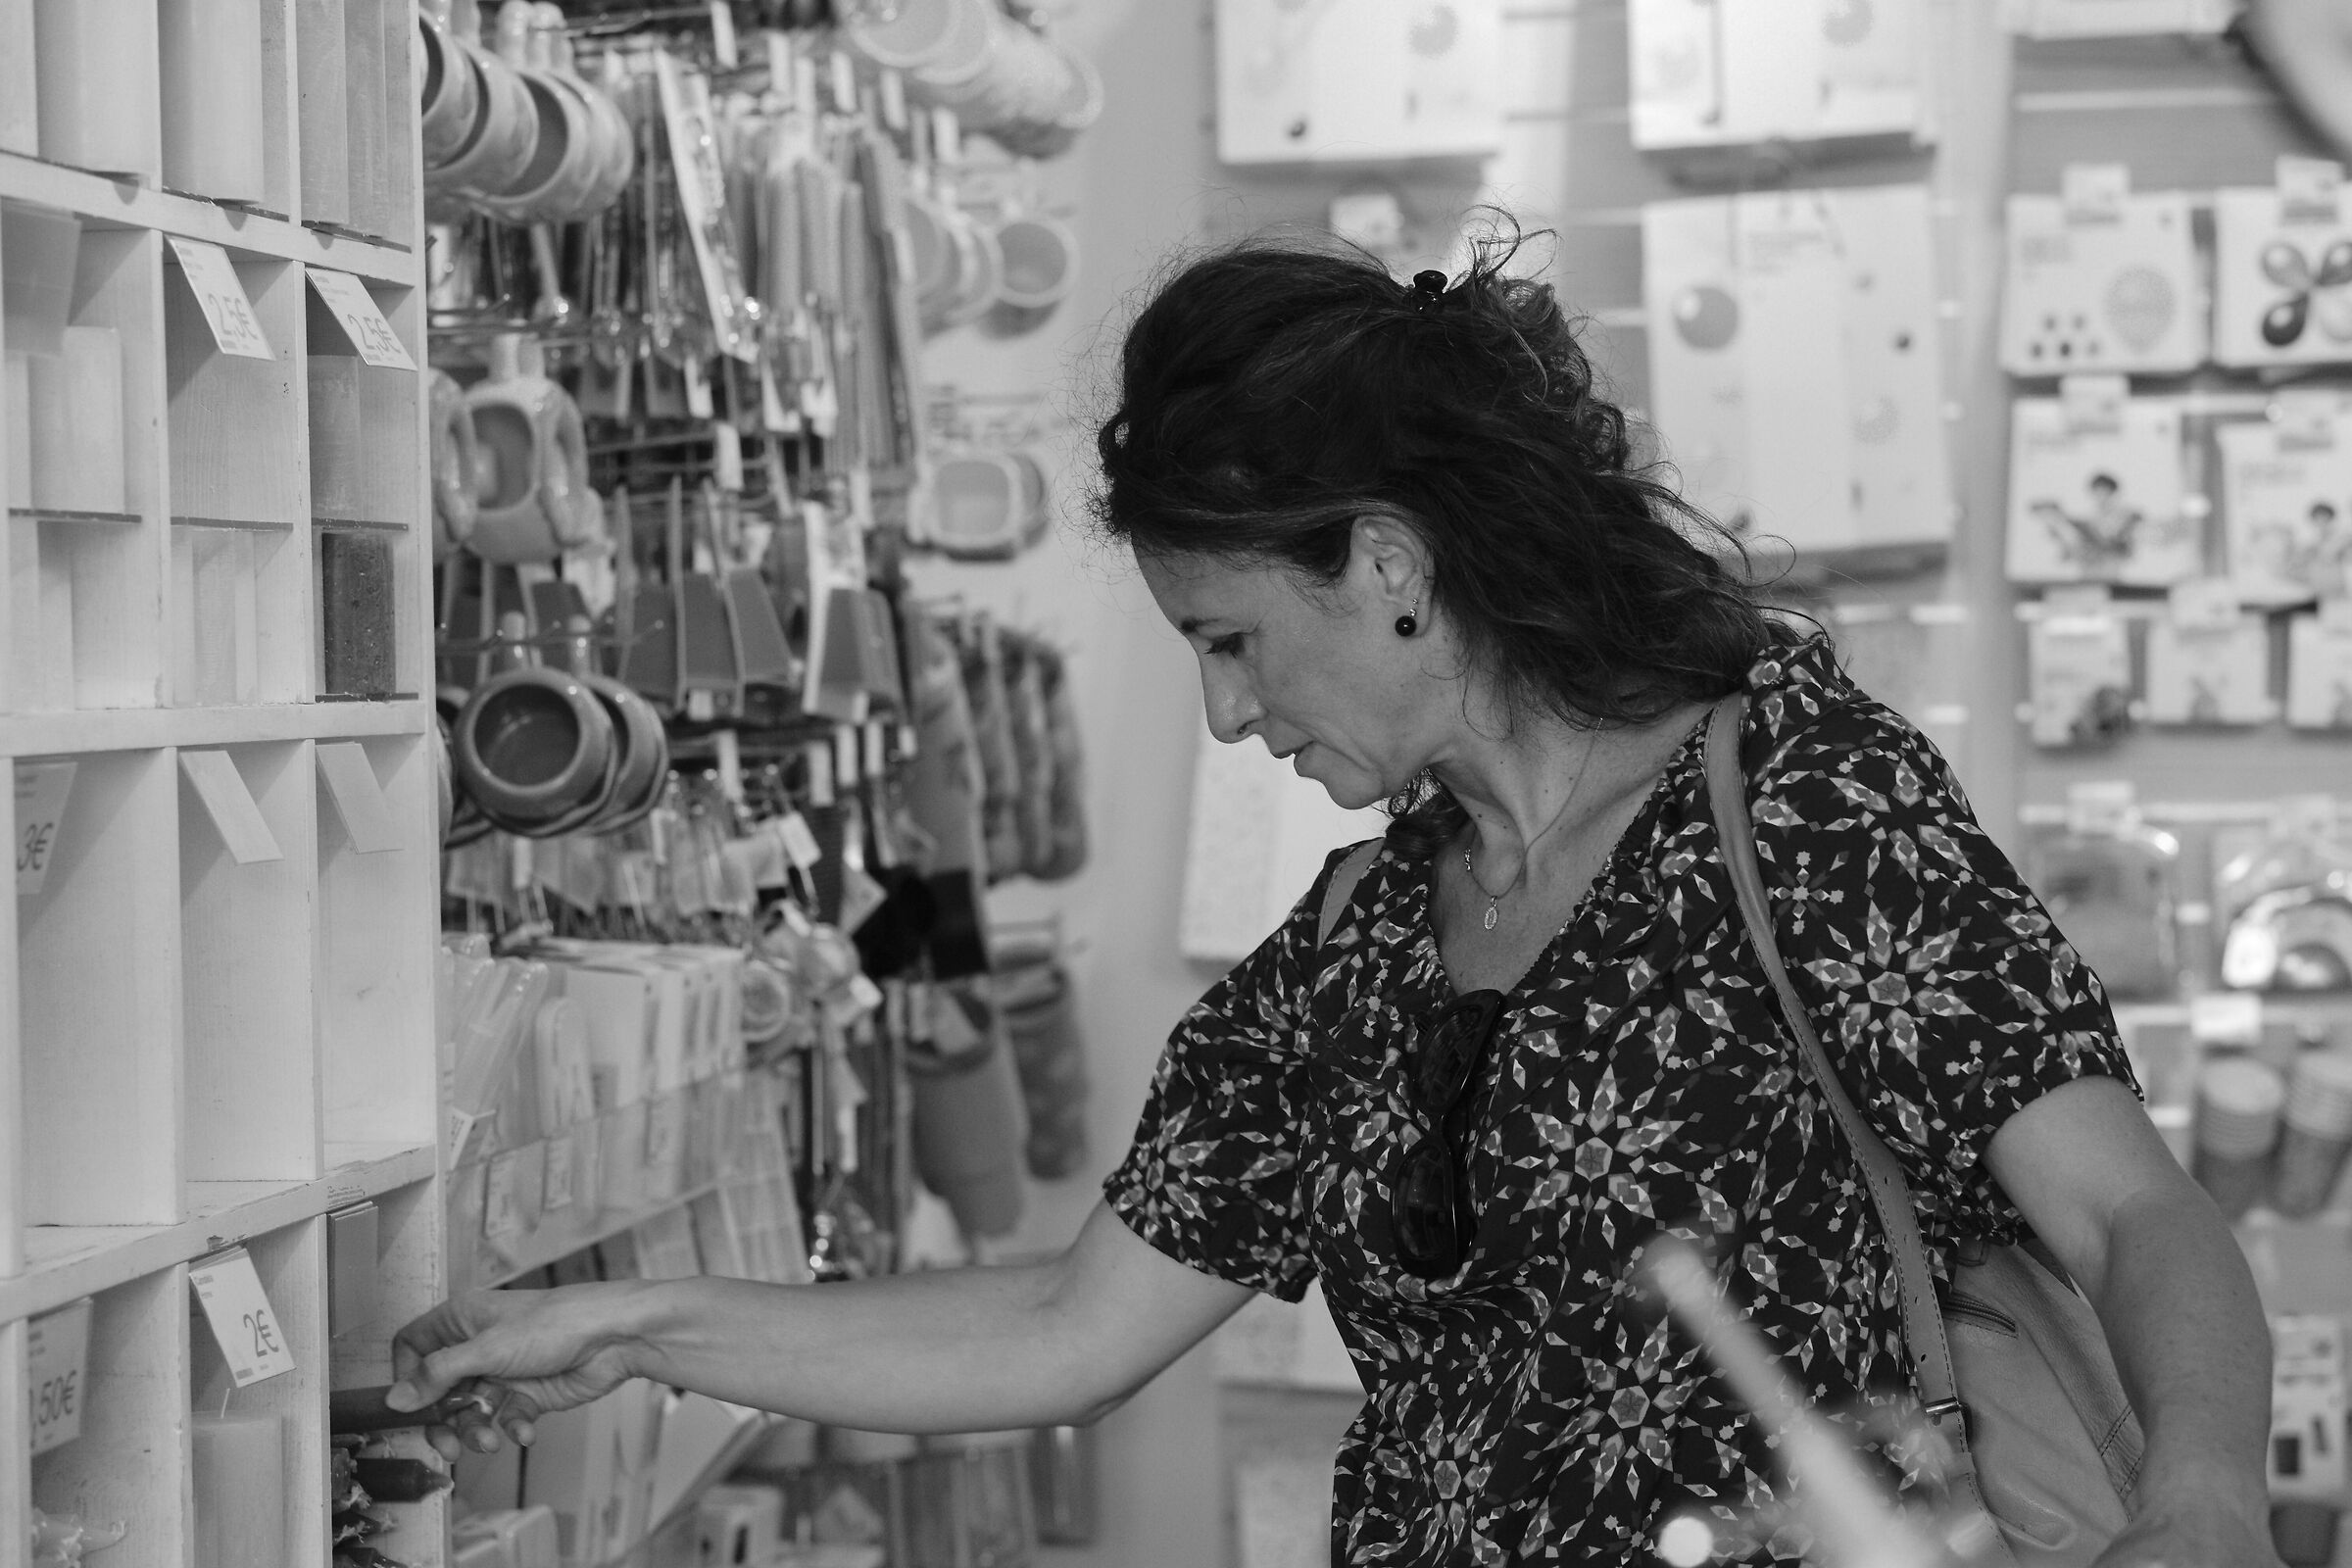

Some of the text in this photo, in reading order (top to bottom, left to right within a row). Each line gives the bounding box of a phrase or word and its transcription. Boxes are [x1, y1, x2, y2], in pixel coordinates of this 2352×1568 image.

[208, 292, 259, 342] 2,5€
[347, 313, 401, 357] 2,5€
[242, 1309, 279, 1357] 2€
